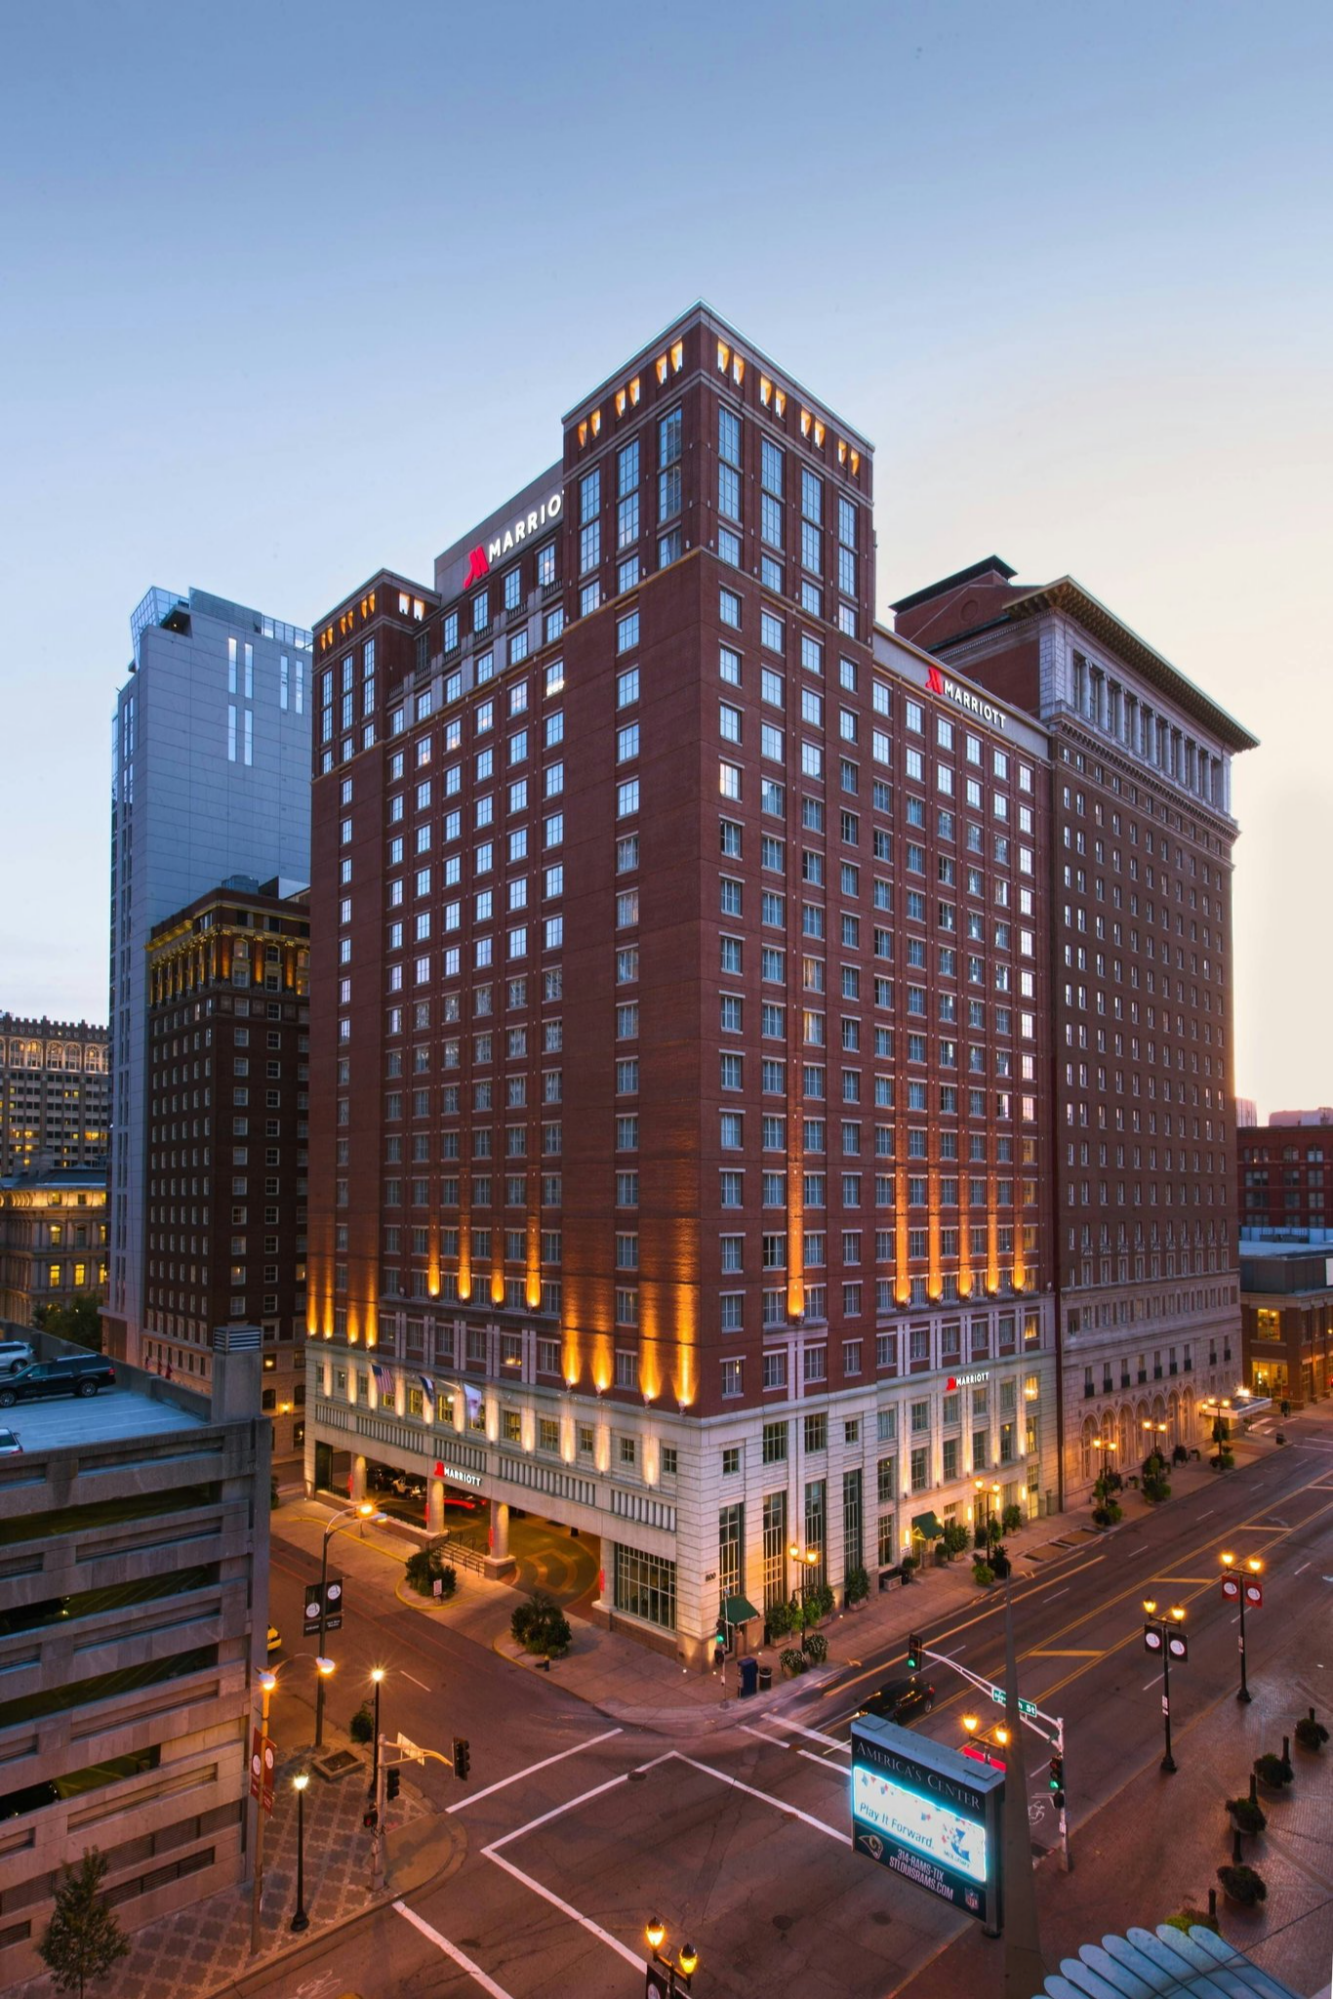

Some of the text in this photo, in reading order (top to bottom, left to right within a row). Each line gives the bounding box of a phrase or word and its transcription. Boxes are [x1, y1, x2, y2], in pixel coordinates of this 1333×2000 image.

[488, 489, 564, 563] MARRIO
[944, 680, 1006, 729] MARRIOTT
[956, 1371, 989, 1387] MARRIOTT
[444, 1467, 481, 1487] MARRIOTT
[1026, 1704, 1035, 1714] St
[857, 1741, 980, 1810] AMERICA'S CENTER
[859, 1802, 935, 1850] Play It Forward.
[889, 1855, 954, 1901] STLOUISRAMS.COM
[897, 1848, 945, 1883] 314-RAMS-TIX
